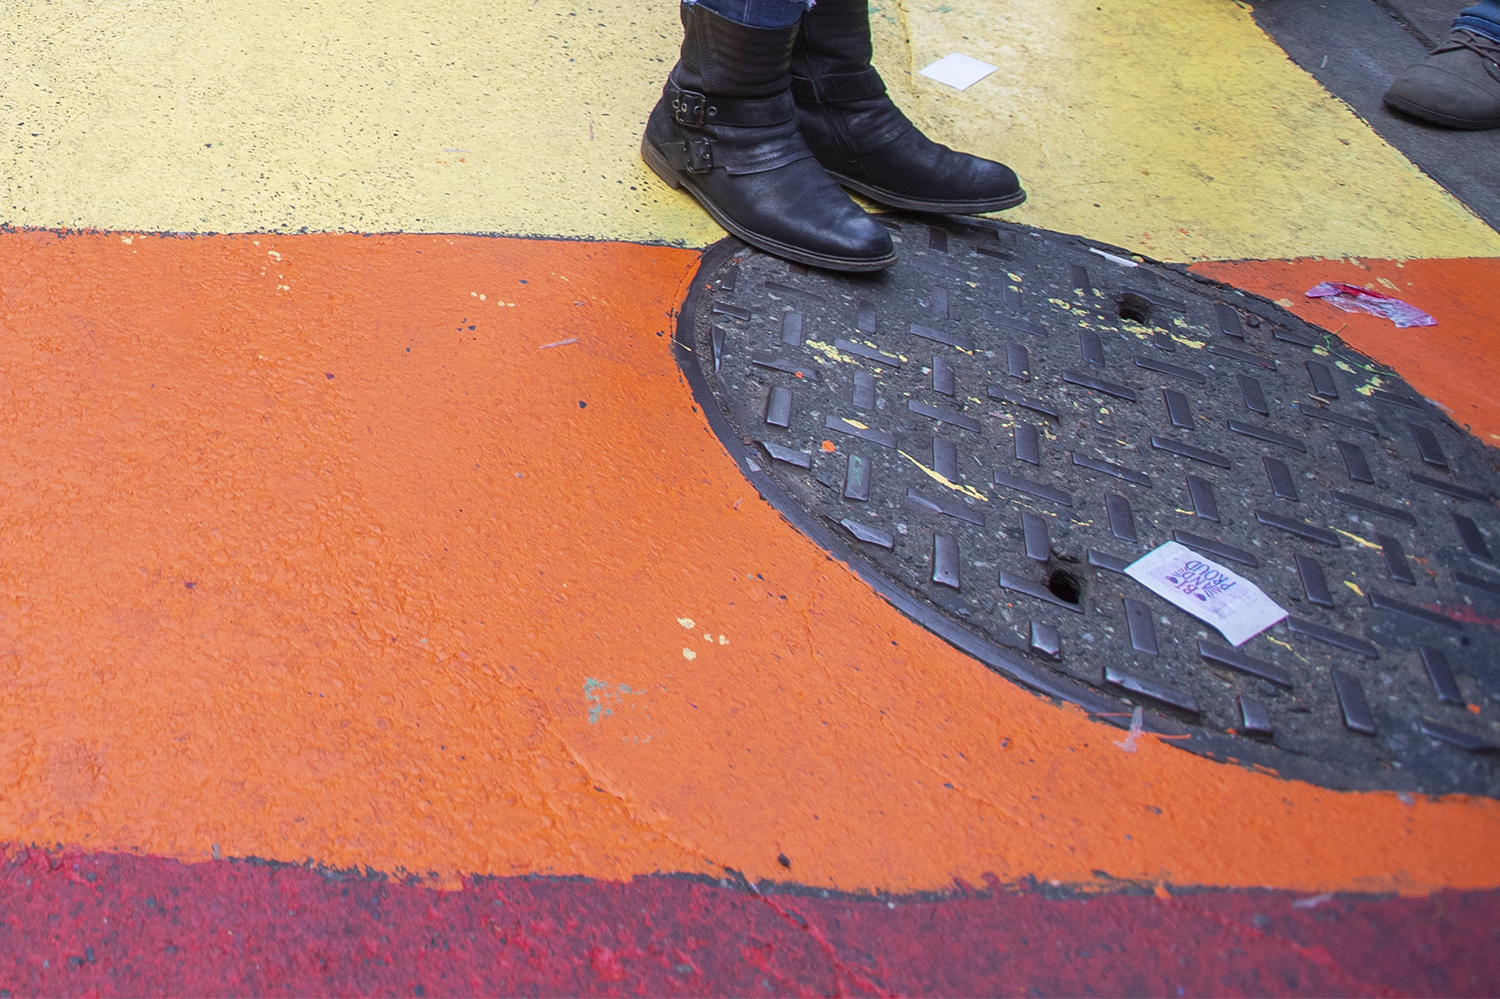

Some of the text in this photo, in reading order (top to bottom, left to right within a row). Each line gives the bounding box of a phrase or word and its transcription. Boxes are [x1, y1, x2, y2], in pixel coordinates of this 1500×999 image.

[1182, 571, 1211, 589] AND
[1186, 560, 1236, 591] PROUD
[1175, 580, 1198, 594] BI
